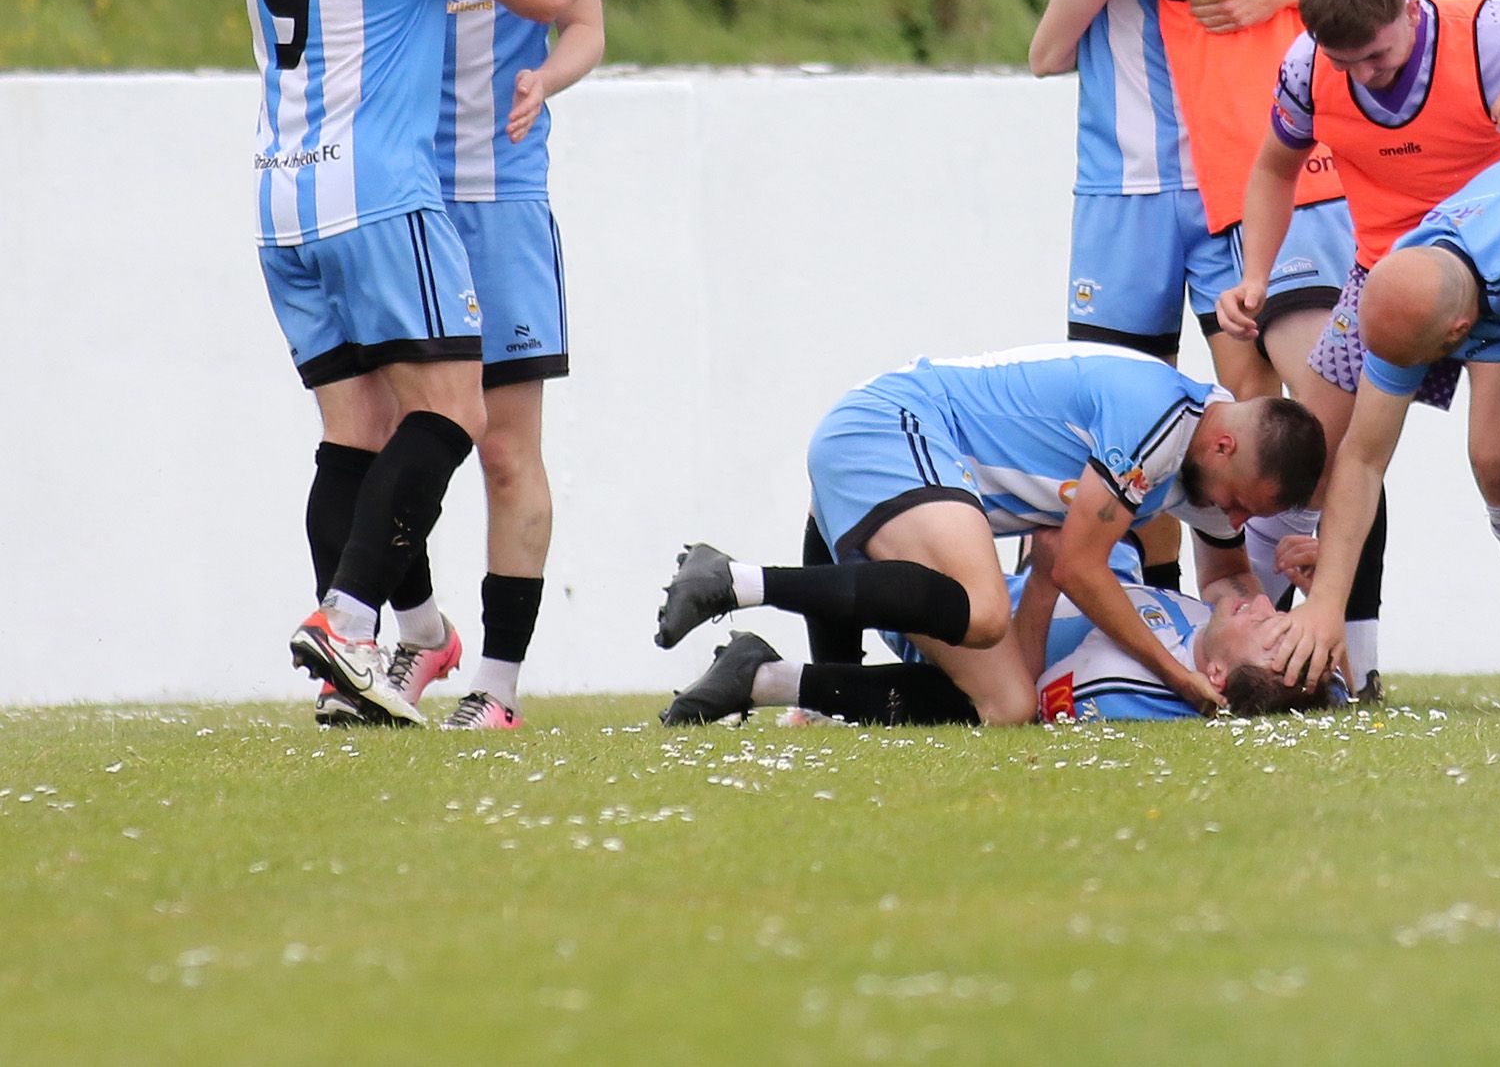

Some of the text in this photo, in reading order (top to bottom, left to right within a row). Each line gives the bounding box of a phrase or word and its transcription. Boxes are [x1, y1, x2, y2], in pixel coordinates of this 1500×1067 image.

[447, 0, 493, 14] lutions
[322, 144, 341, 161] FC
[1379, 142, 1422, 158] oneills
[505, 337, 543, 353] oneills
